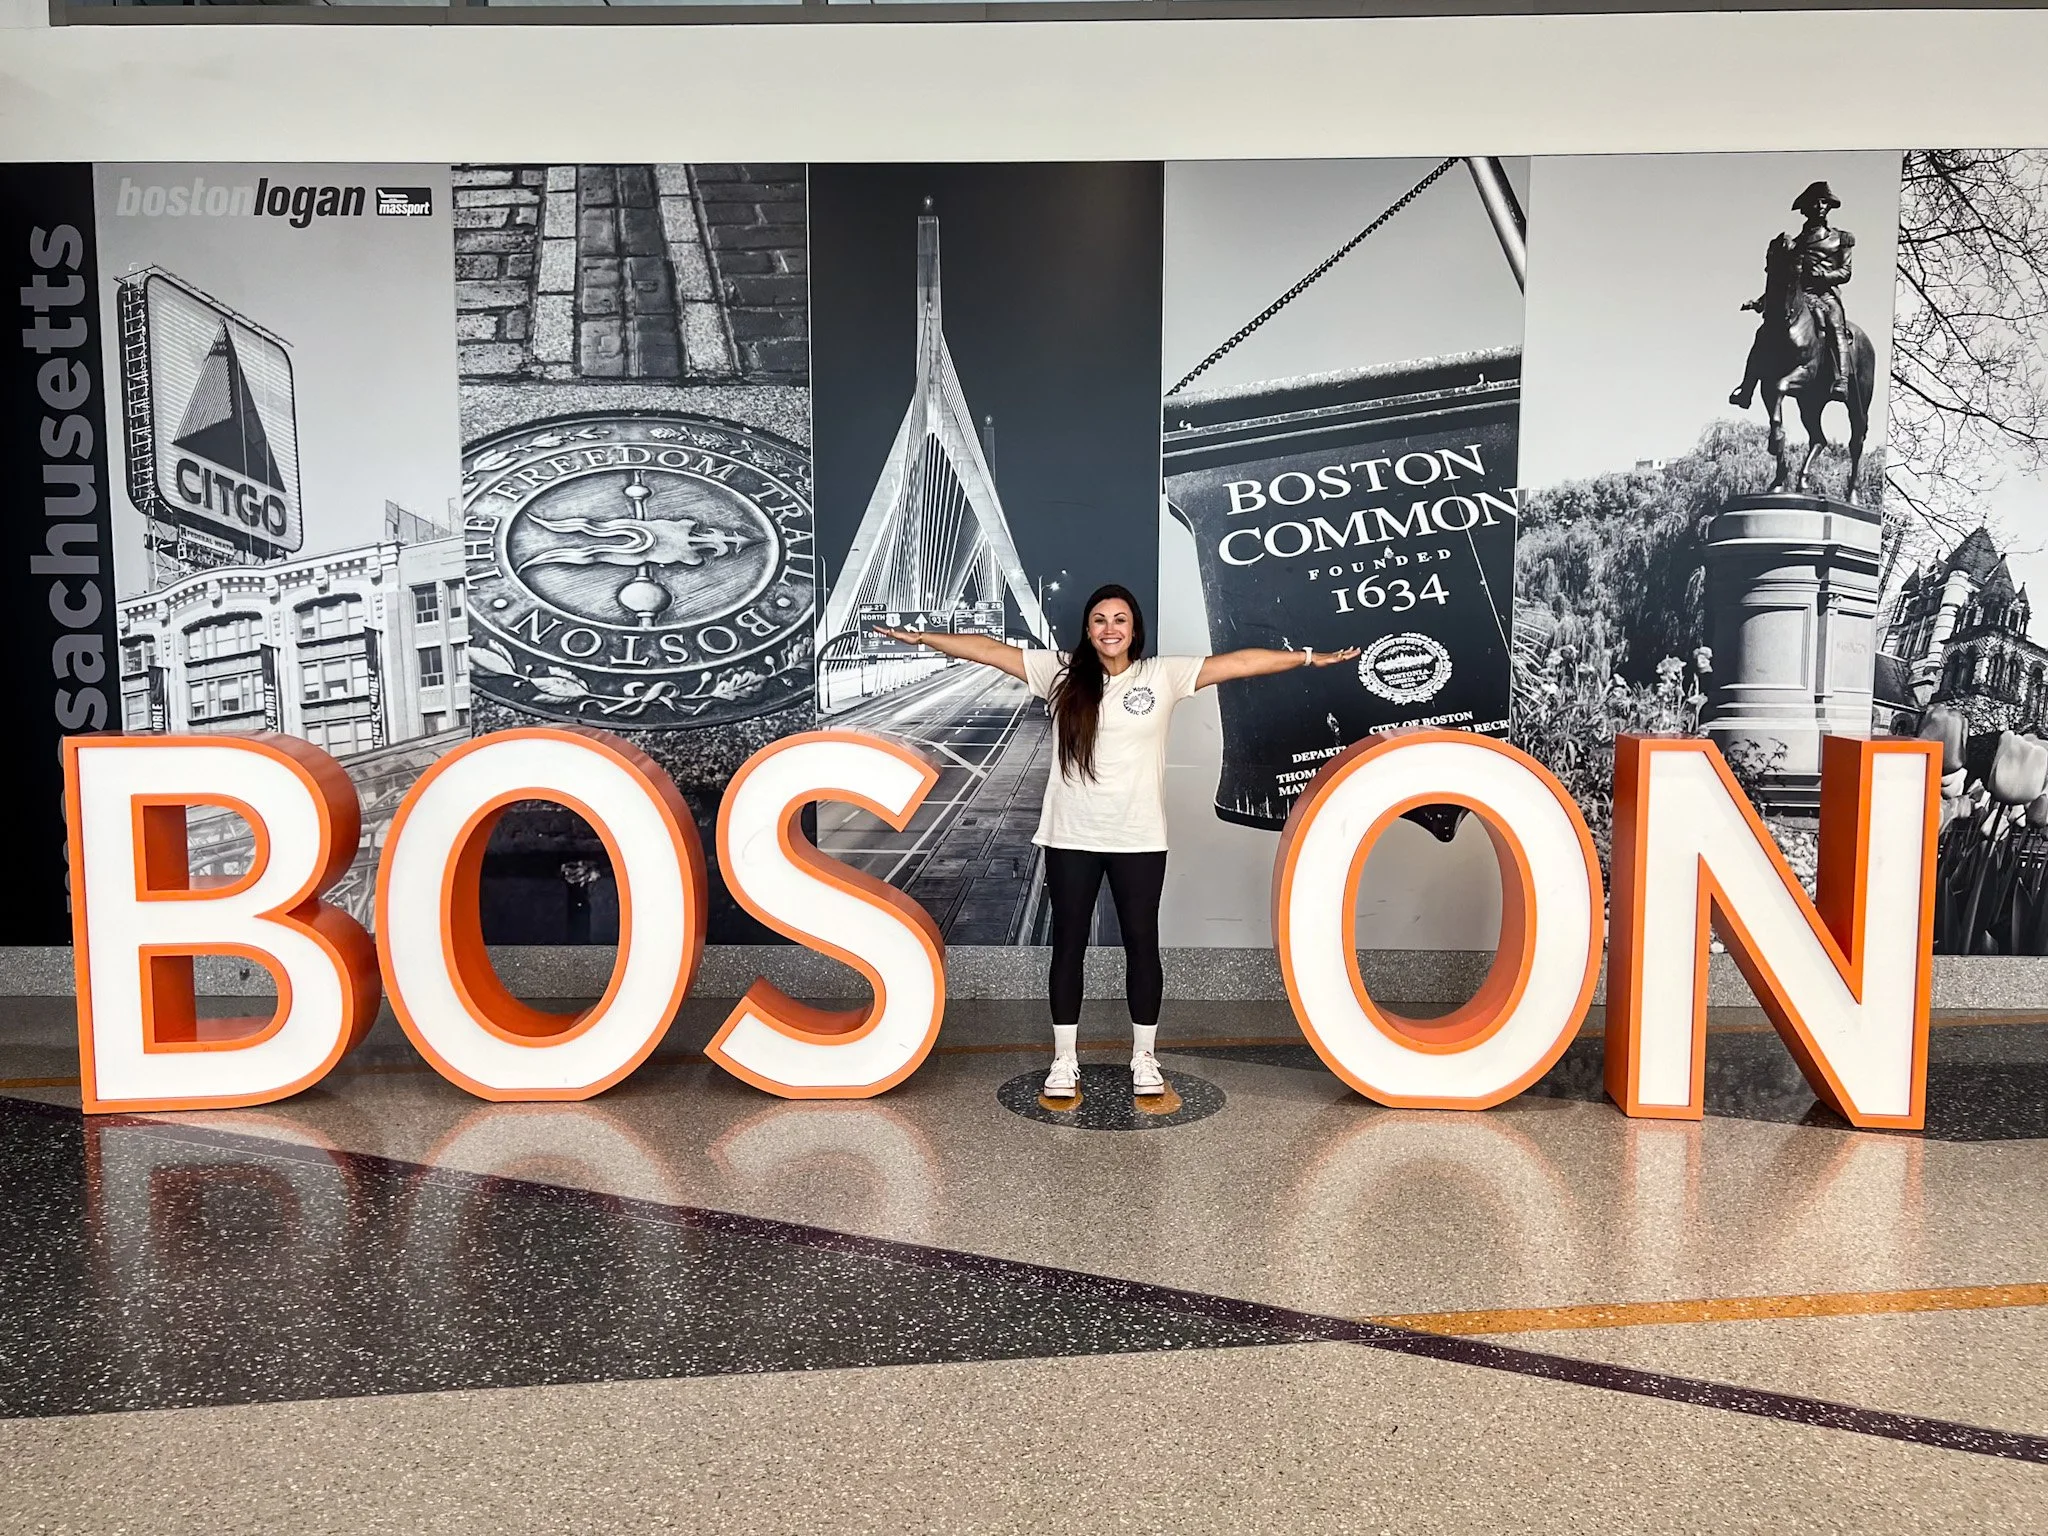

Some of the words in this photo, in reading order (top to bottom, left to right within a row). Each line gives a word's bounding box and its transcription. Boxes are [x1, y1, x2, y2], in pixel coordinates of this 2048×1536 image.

[378, 201, 431, 217] massport
[176, 458, 287, 537] CITGO
[1222, 443, 1486, 516] BOSTON
[464, 515, 503, 591] THE
[489, 446, 738, 501] FREEDOM
[751, 482, 814, 587] TRAIL
[1218, 487, 1518, 567] COMMON
[20, 222, 108, 914] sachusetts
[1307, 548, 1452, 582] FOUNDED
[860, 613, 886, 621] NORTH
[1331, 572, 1451, 614] 1634
[510, 608, 781, 667] BOSTON
[1421, 710, 1474, 727] BOSTON
[1473, 719, 1511, 734] RECR
